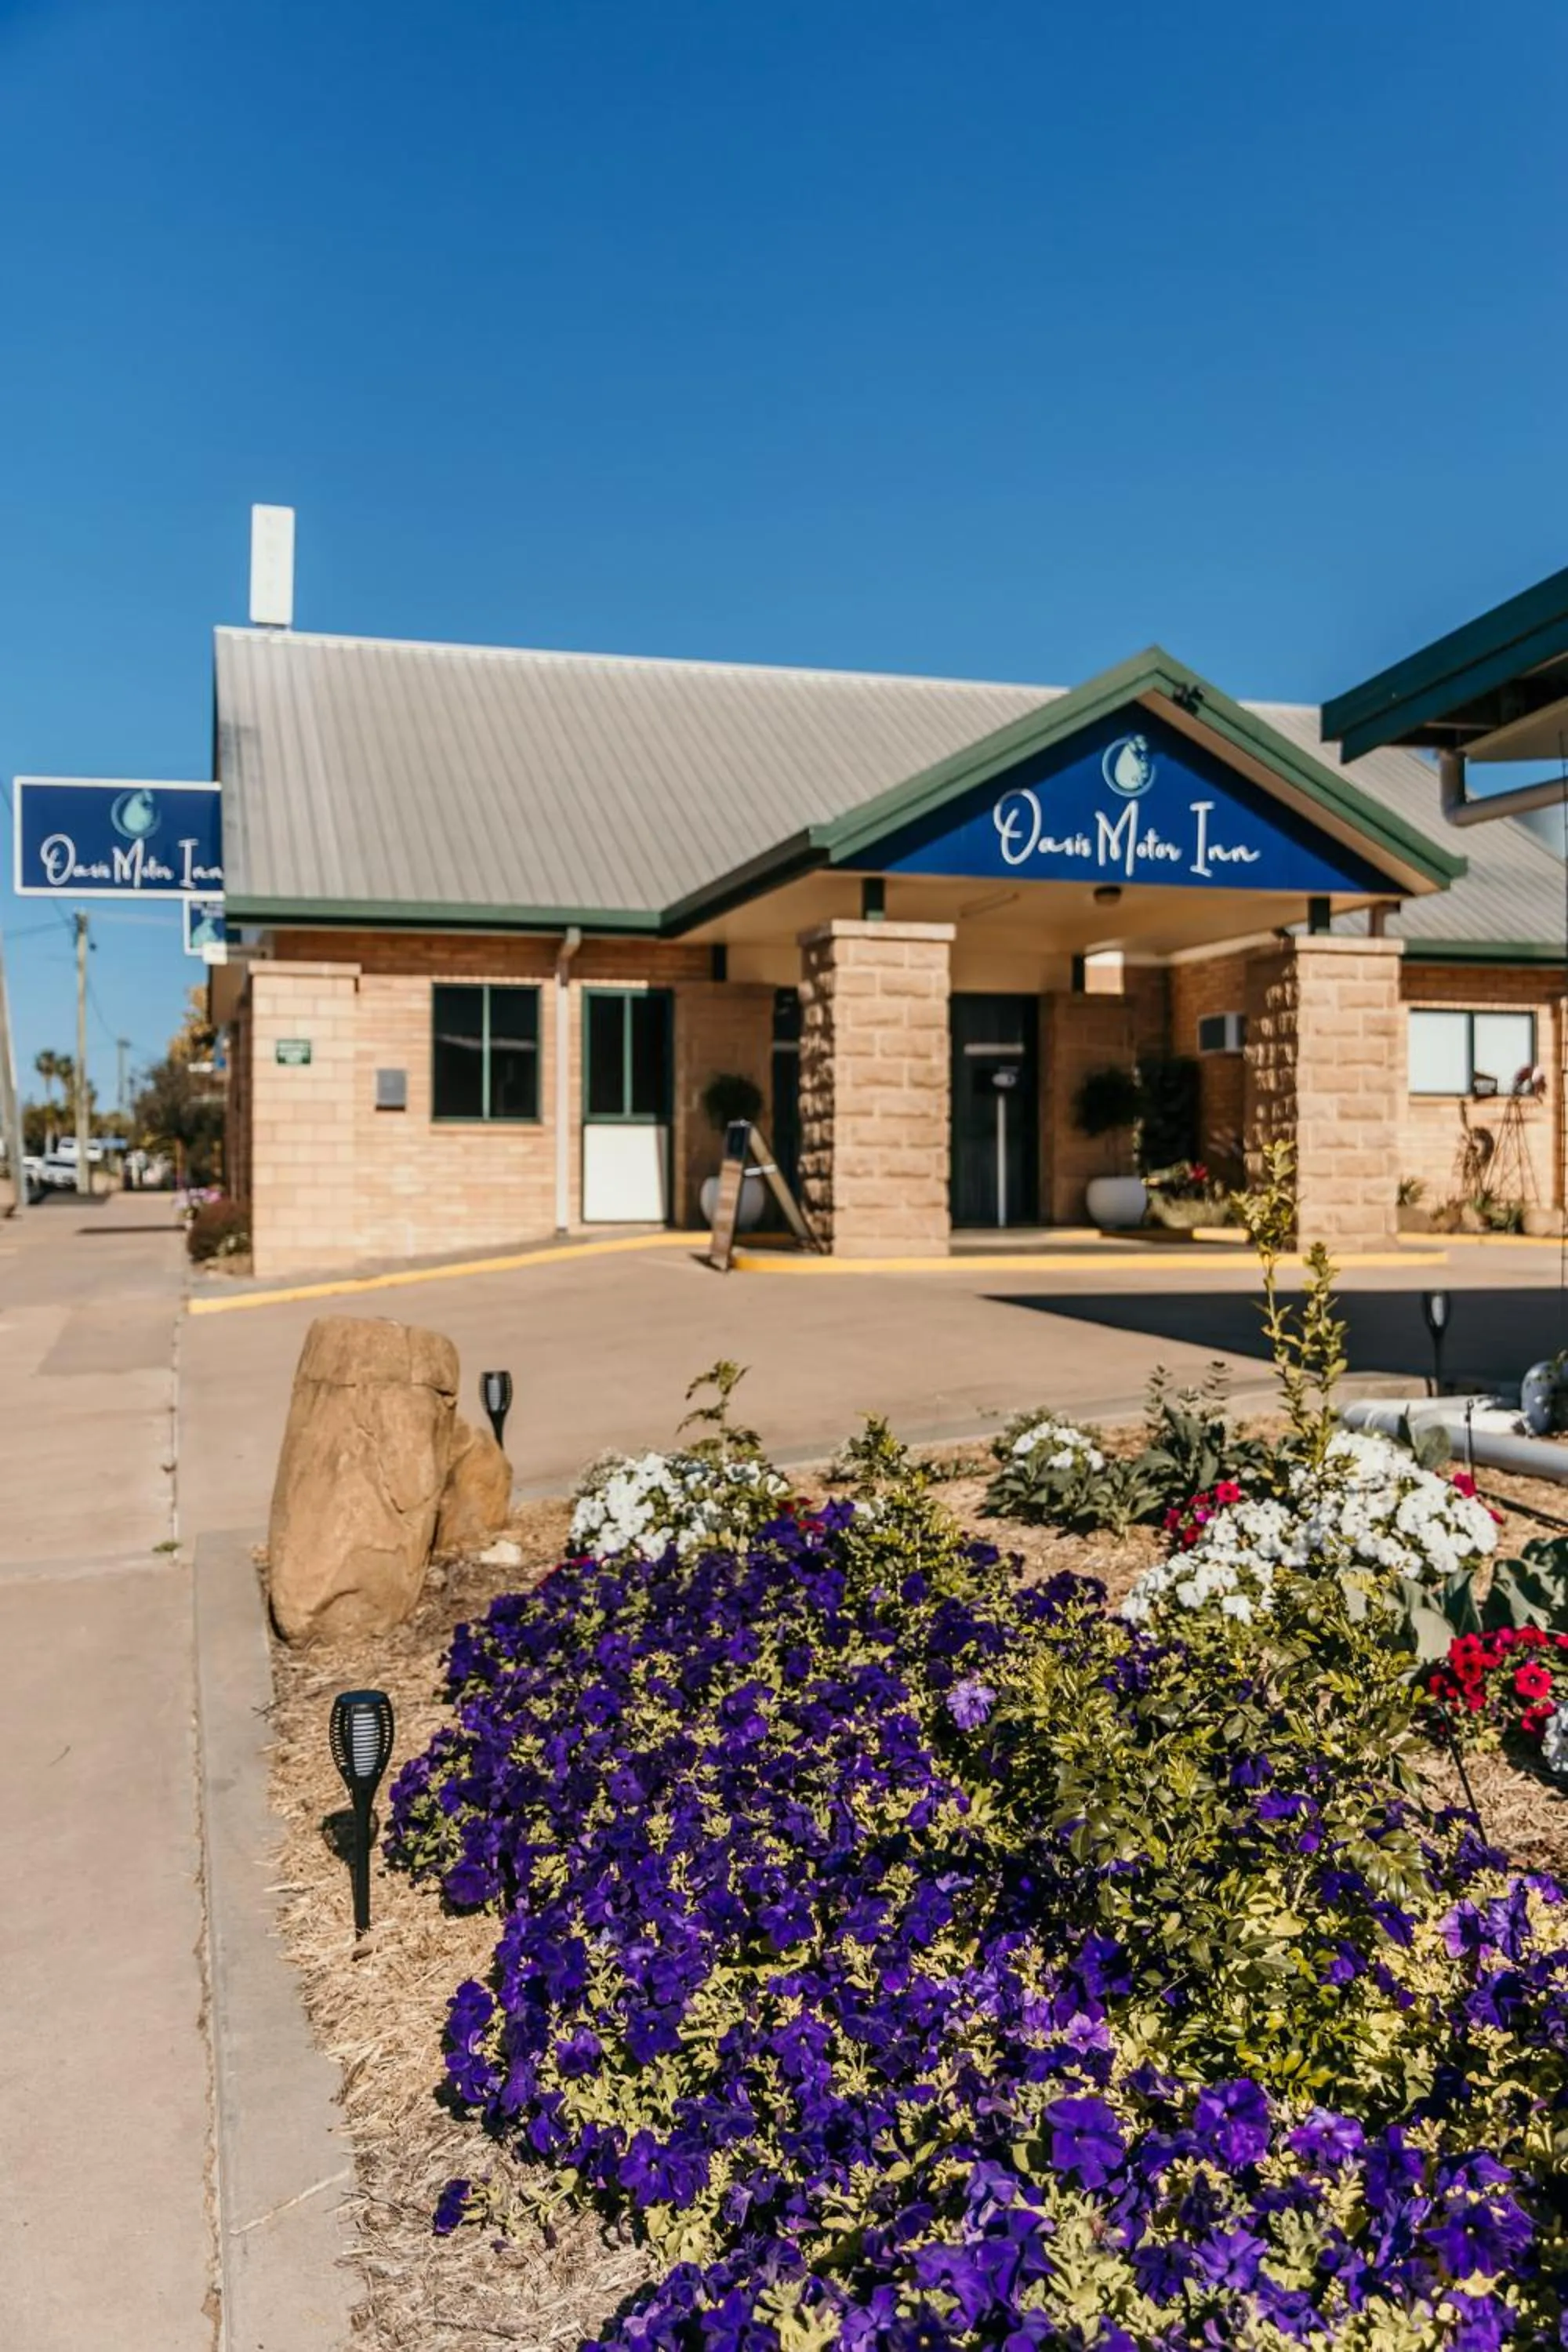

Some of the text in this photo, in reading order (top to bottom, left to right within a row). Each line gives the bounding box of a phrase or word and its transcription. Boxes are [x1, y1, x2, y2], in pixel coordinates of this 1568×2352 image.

[40, 833, 111, 886] Oasis
[993, 788, 1261, 877] Oasis Motor Inn
